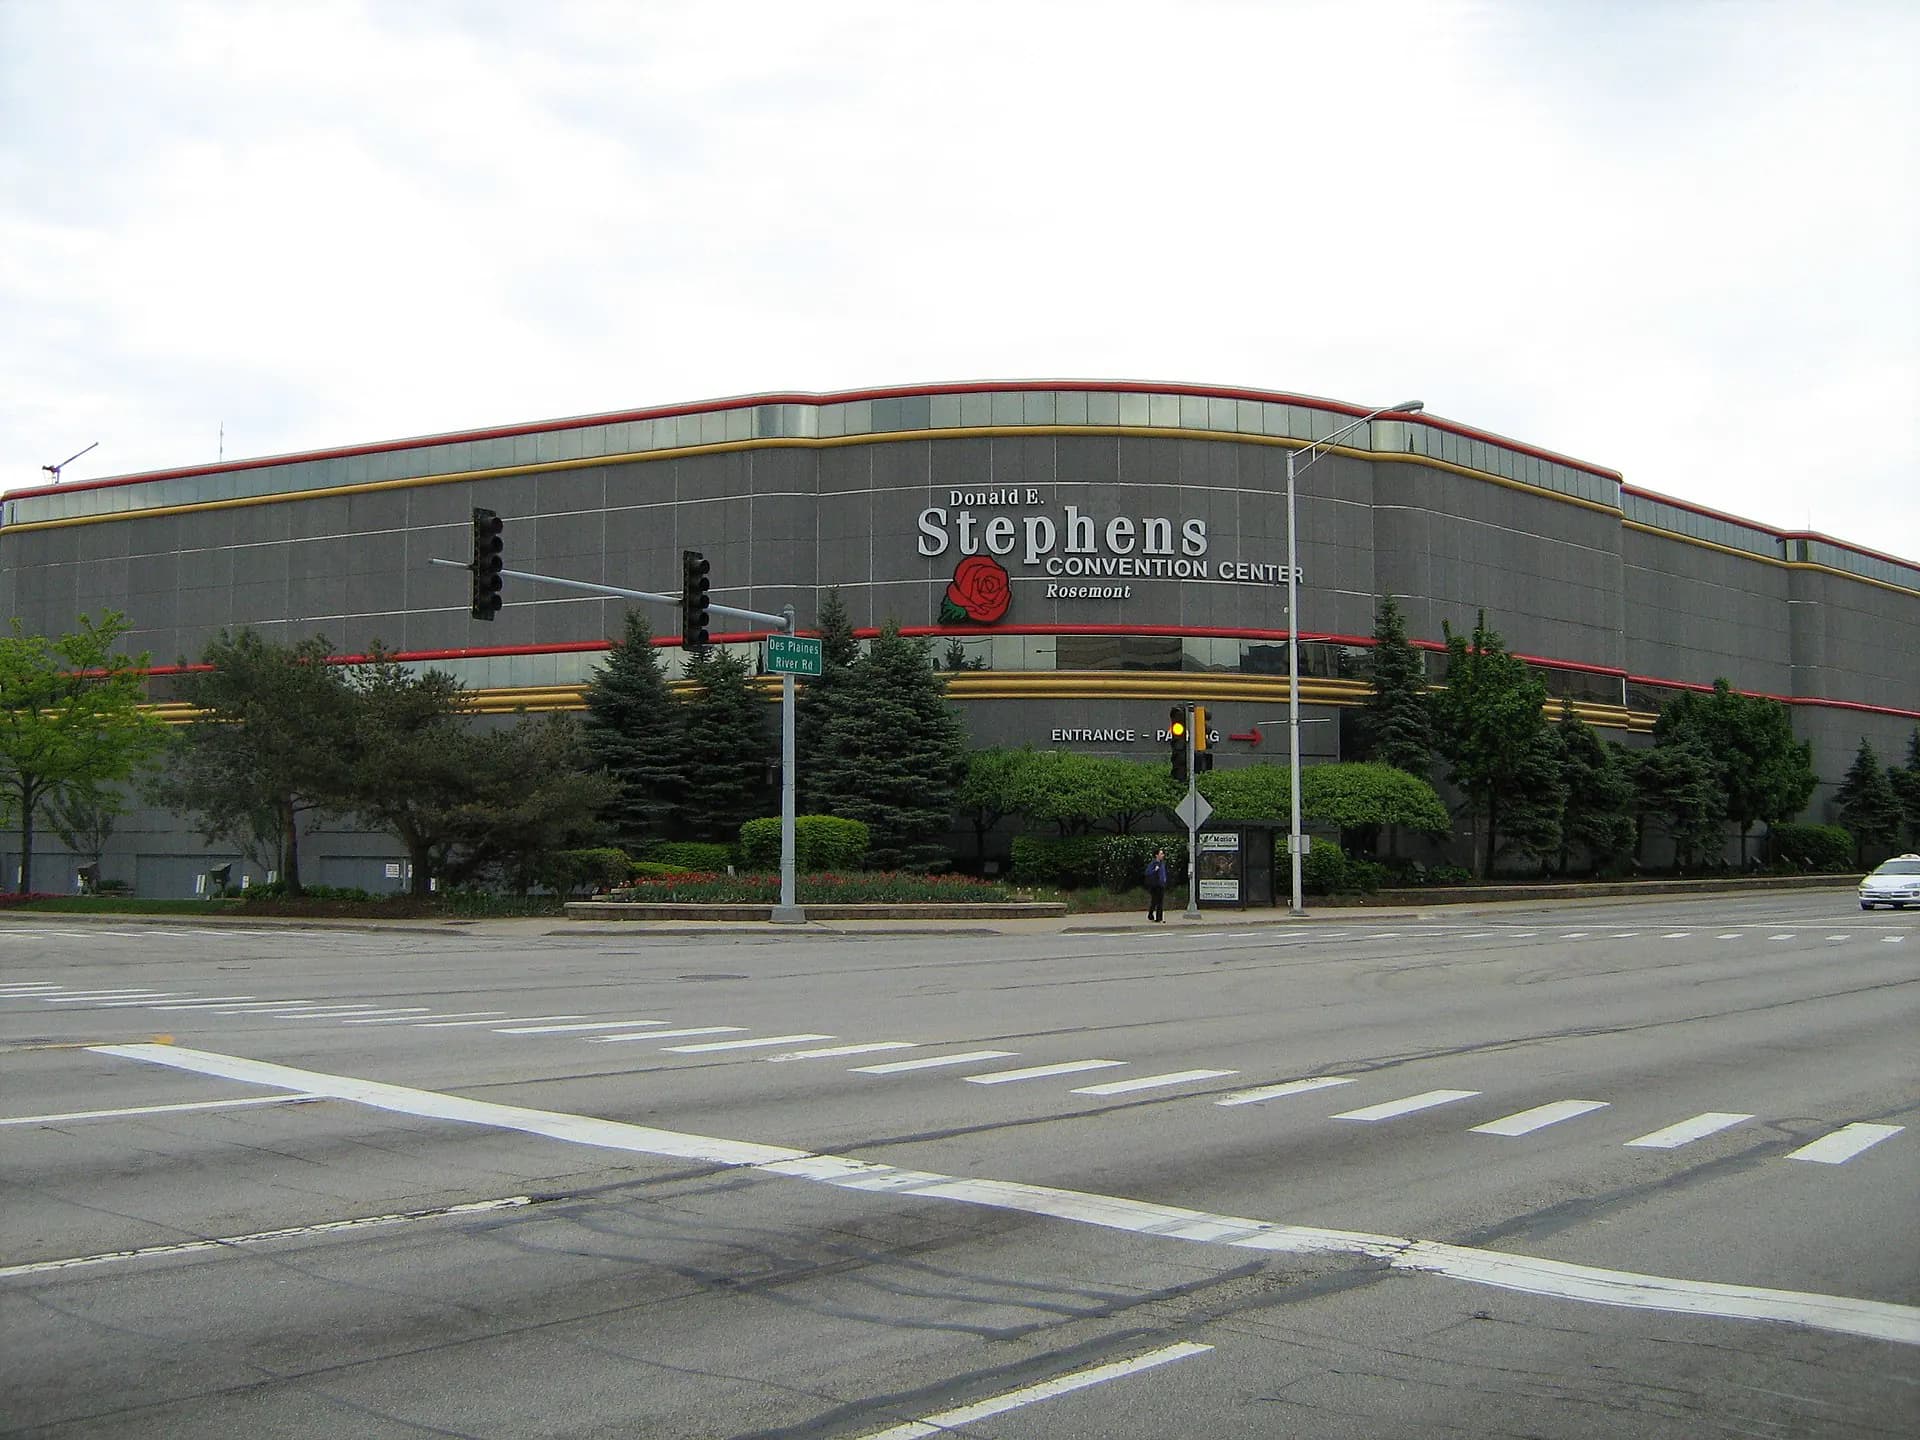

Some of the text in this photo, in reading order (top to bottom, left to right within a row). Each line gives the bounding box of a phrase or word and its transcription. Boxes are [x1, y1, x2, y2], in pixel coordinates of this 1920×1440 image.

[950, 488, 1045, 506] Donald E.
[917, 505, 1208, 565] Stephens
[1046, 557, 1304, 584] CONVENTION CENTER
[1046, 583, 1131, 599] Rosemont
[769, 639, 819, 655] Des Plaines
[775, 656, 813, 671] River Rd
[1051, 728, 1136, 742] ENTRANCE
